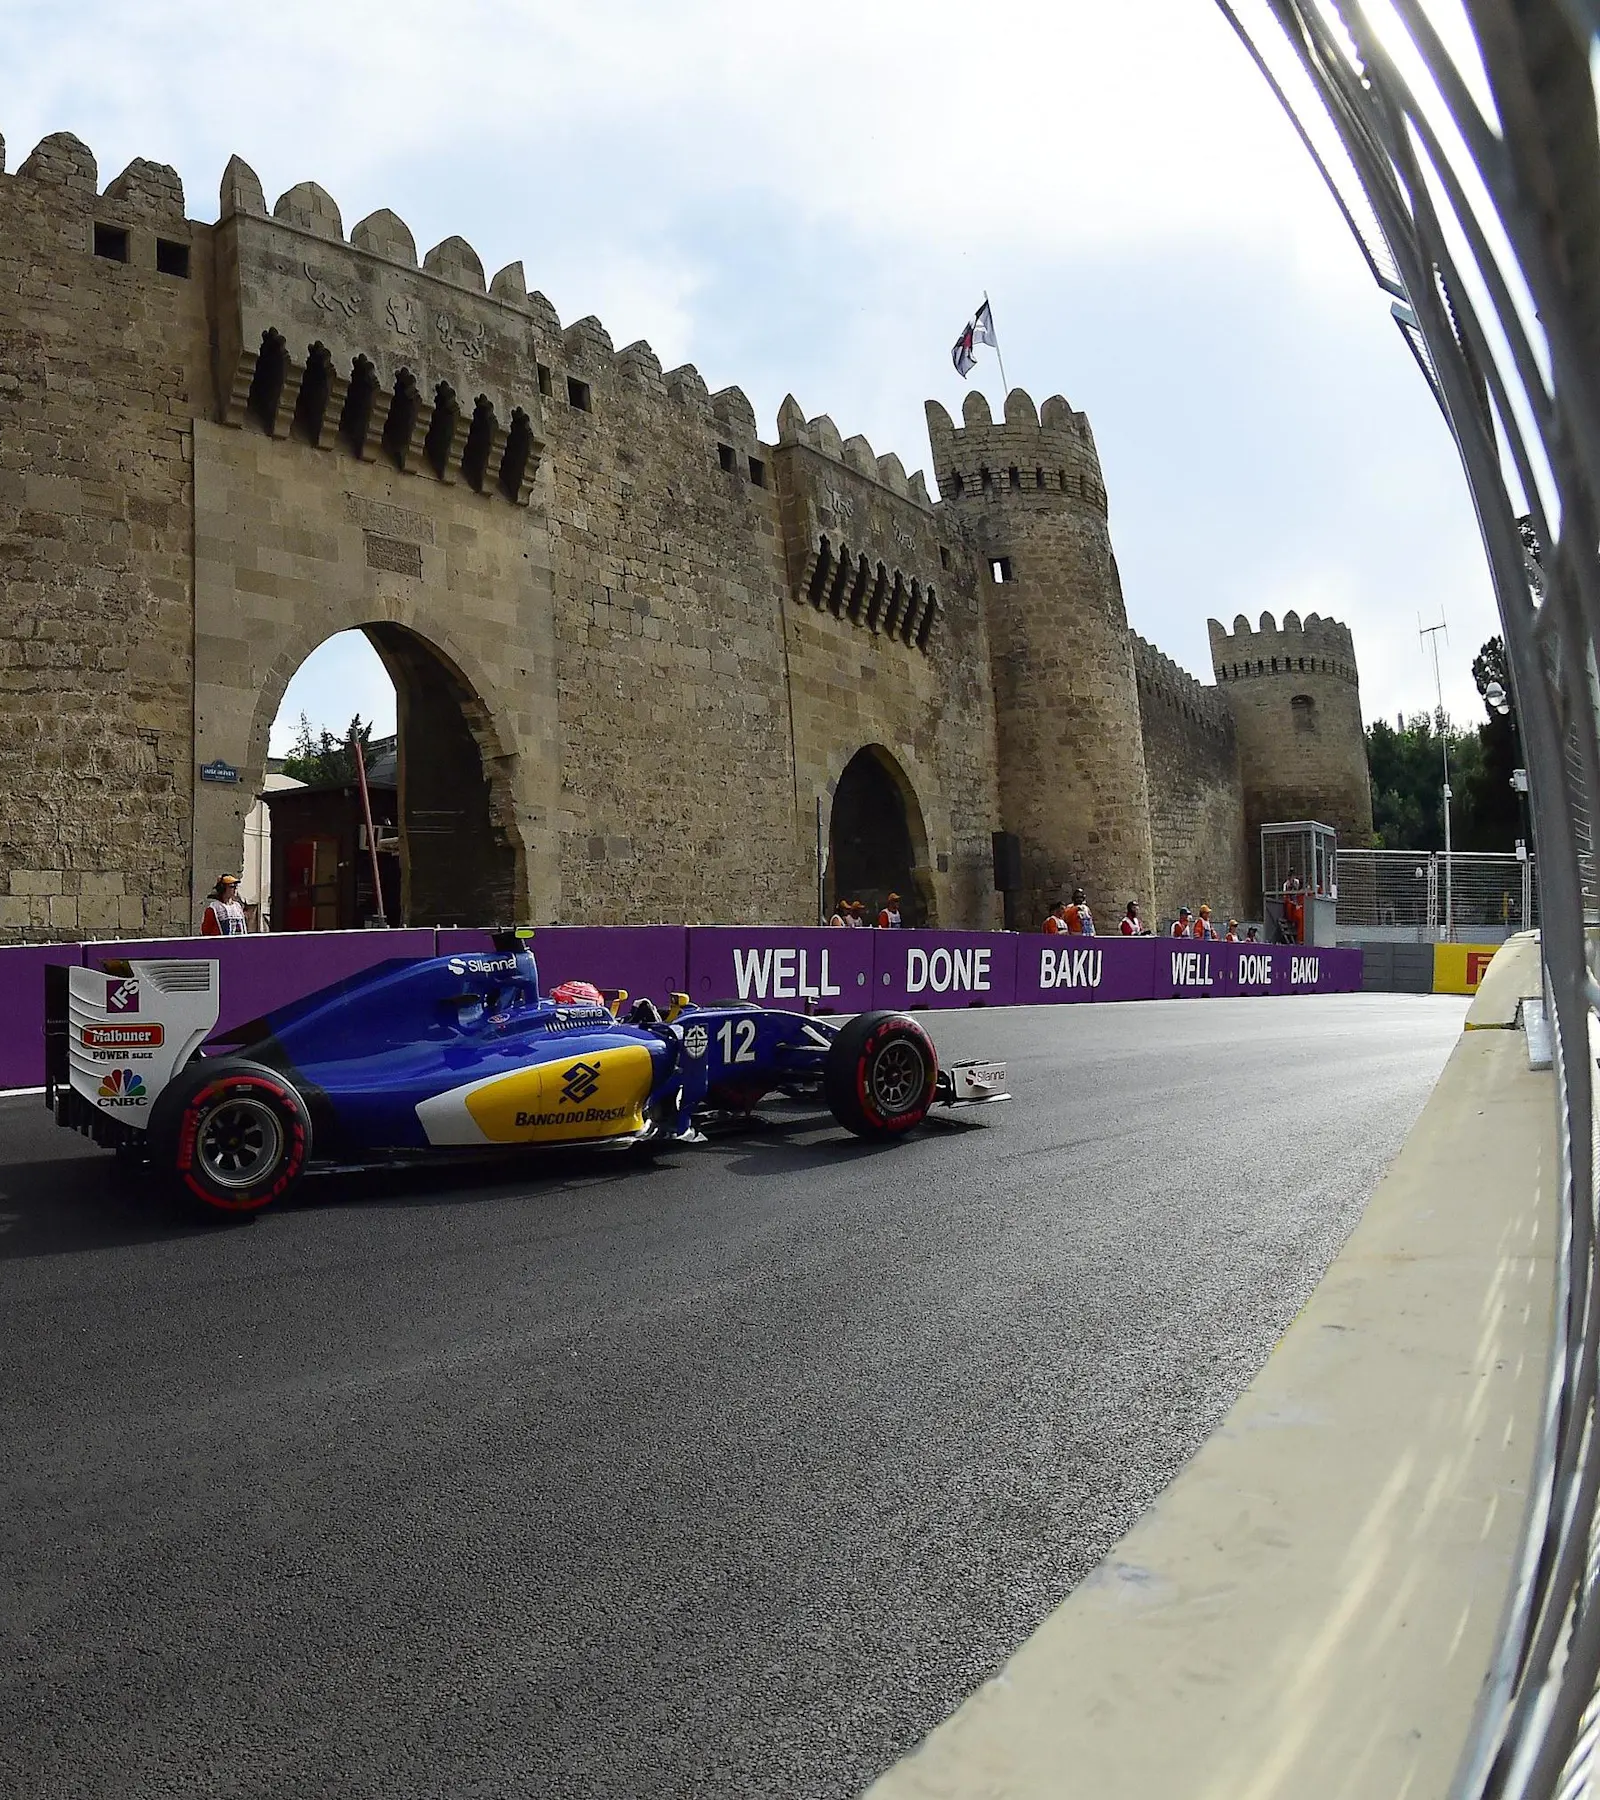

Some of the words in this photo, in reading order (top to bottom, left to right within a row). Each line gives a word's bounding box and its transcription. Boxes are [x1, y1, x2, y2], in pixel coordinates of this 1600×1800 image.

[468, 953, 516, 973] Silanna
[1171, 953, 1213, 986] WELL
[1238, 955, 1272, 984] DONE
[1290, 957, 1319, 985] BAKU
[733, 949, 840, 998] WELL
[906, 949, 990, 993] DONE
[1039, 949, 1102, 988] BAKU
[110, 980, 139, 1009] IFS
[569, 1008, 603, 1018] Silanna
[92, 1030, 152, 1043] Malbuner
[717, 1019, 756, 1064] 12
[92, 1051, 129, 1060] POWER
[97, 1097, 149, 1107] CNBC
[515, 1112, 563, 1126] BANCO
[566, 1110, 584, 1123] DO
[586, 1106, 626, 1122] BRASIL
